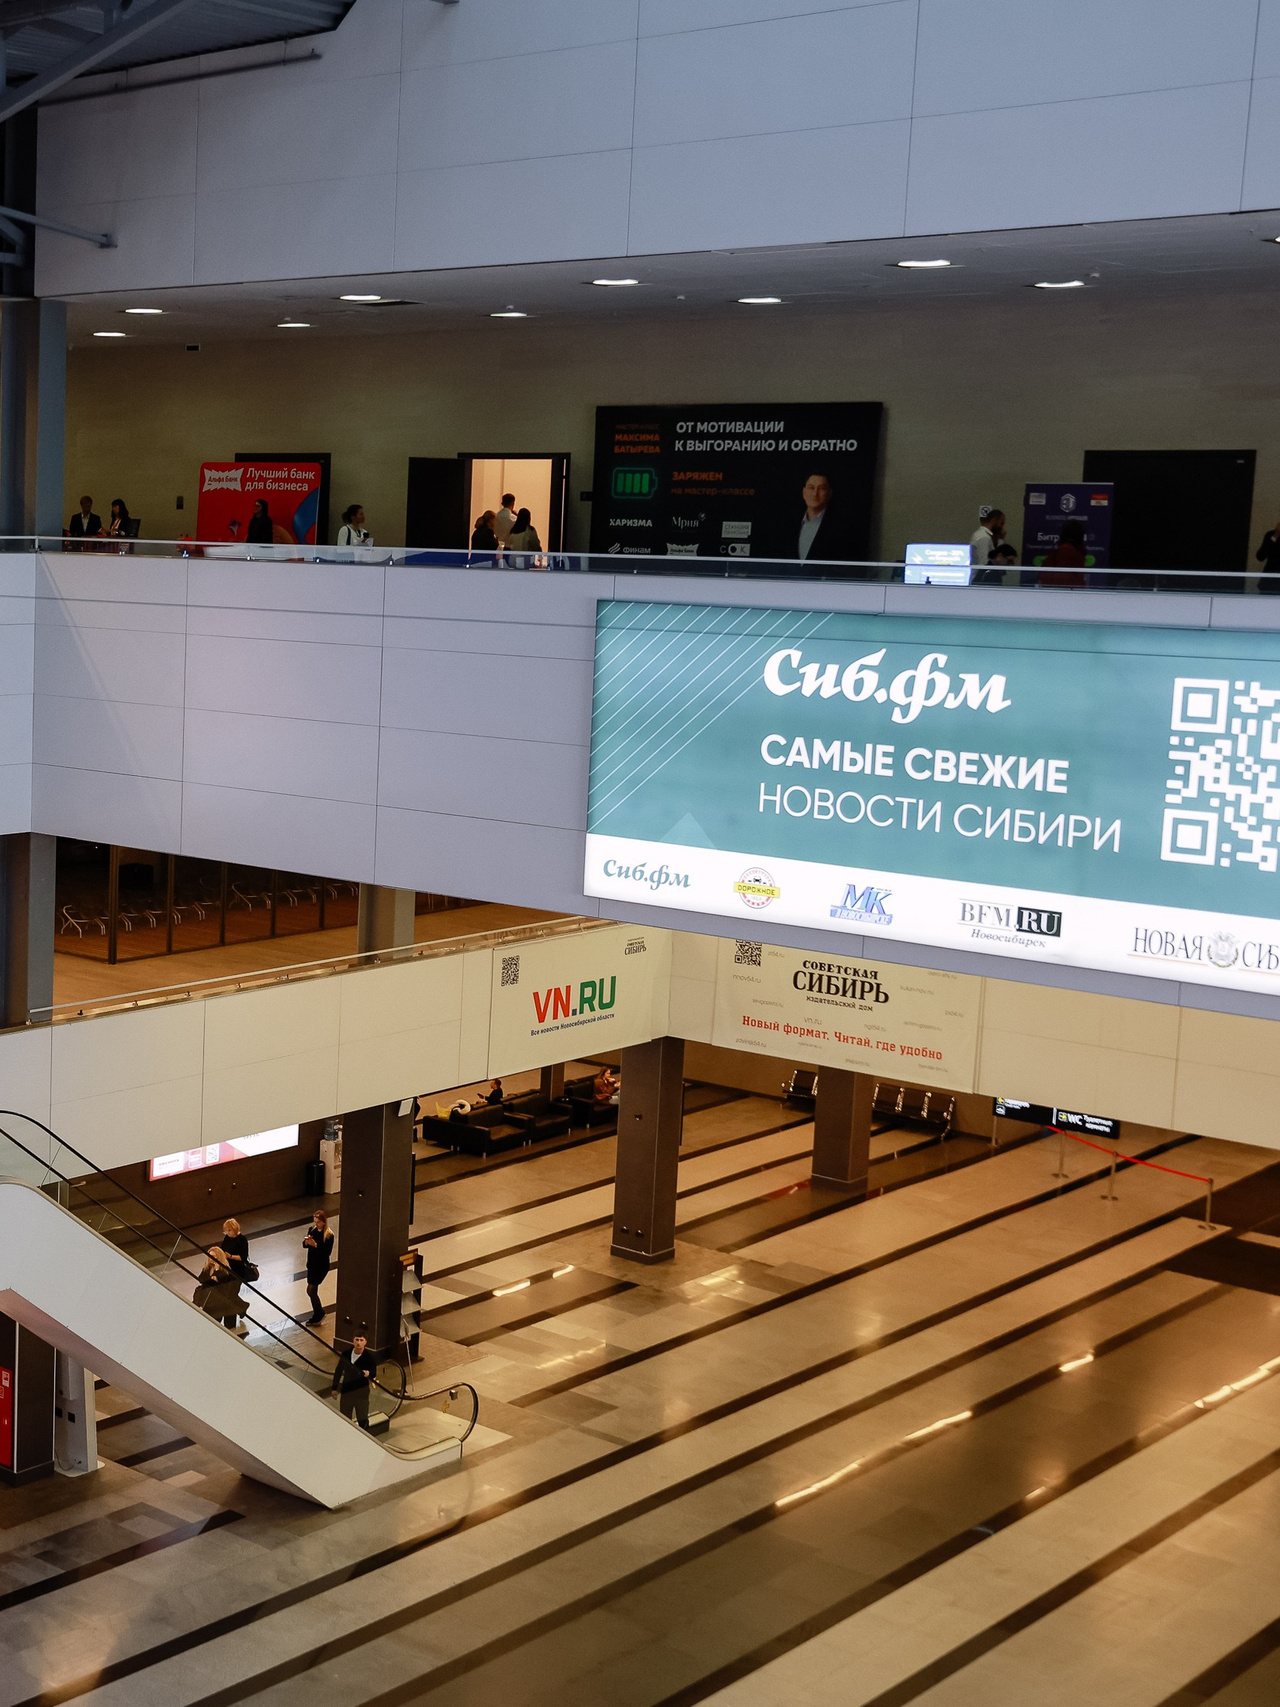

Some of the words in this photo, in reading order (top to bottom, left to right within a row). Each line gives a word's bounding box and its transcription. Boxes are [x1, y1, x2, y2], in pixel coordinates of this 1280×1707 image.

[614, 433, 660, 442] МАКСИМА
[676, 421, 694, 433] ОТ
[696, 421, 784, 435] МОТИВАЦИИ
[613, 445, 660, 454] БАТЫРЕВА
[675, 440, 687, 451] К
[688, 440, 775, 451] ВЫГОРАНИЮ
[778, 440, 789, 451] И
[791, 439, 857, 451] ОБРАТНО
[247, 467, 288, 481] Лучший
[290, 468, 316, 480] банк
[672, 472, 723, 481] ЗАРЯЖЕН
[245, 482, 264, 492] для
[266, 479, 309, 491] бизнеса
[609, 518, 653, 527] ХАРИЗМА
[672, 516, 699, 529] Мрия
[763, 647, 1012, 725] Сиб.фм
[760, 734, 895, 779] САМЫЕ
[904, 747, 1069, 795] СВЕЖИЕ
[758, 782, 941, 834] НОВОСТИ
[953, 804, 1122, 854] СИБИРИ
[603, 859, 691, 890] Сиб.фм
[840, 884, 894, 916] МК
[959, 902, 1061, 936] BFM.RU
[970, 928, 1046, 948] Новосибирск
[1134, 927, 1203, 961] НОВАЯ
[624, 944, 647, 956] СИБИРЬ
[802, 959, 879, 981] СОВЕТСКАЯ
[793, 970, 890, 1004] СИБИРЬ
[532, 975, 617, 1024] VN.RU
[806, 995, 857, 1010] издательский
[858, 1004, 874, 1012] дом
[531, 1029, 540, 1037] Все
[540, 1026, 560, 1034] новости
[560, 1015, 596, 1030] Новосибирской
[596, 1013, 615, 1022] области
[742, 1015, 780, 1032] Новый
[783, 1022, 830, 1041] формат.
[834, 1031, 873, 1049] Читай,
[876, 1040, 896, 1053] где
[899, 1043, 943, 1061] удобно
[1068, 1113, 1083, 1126] WC
